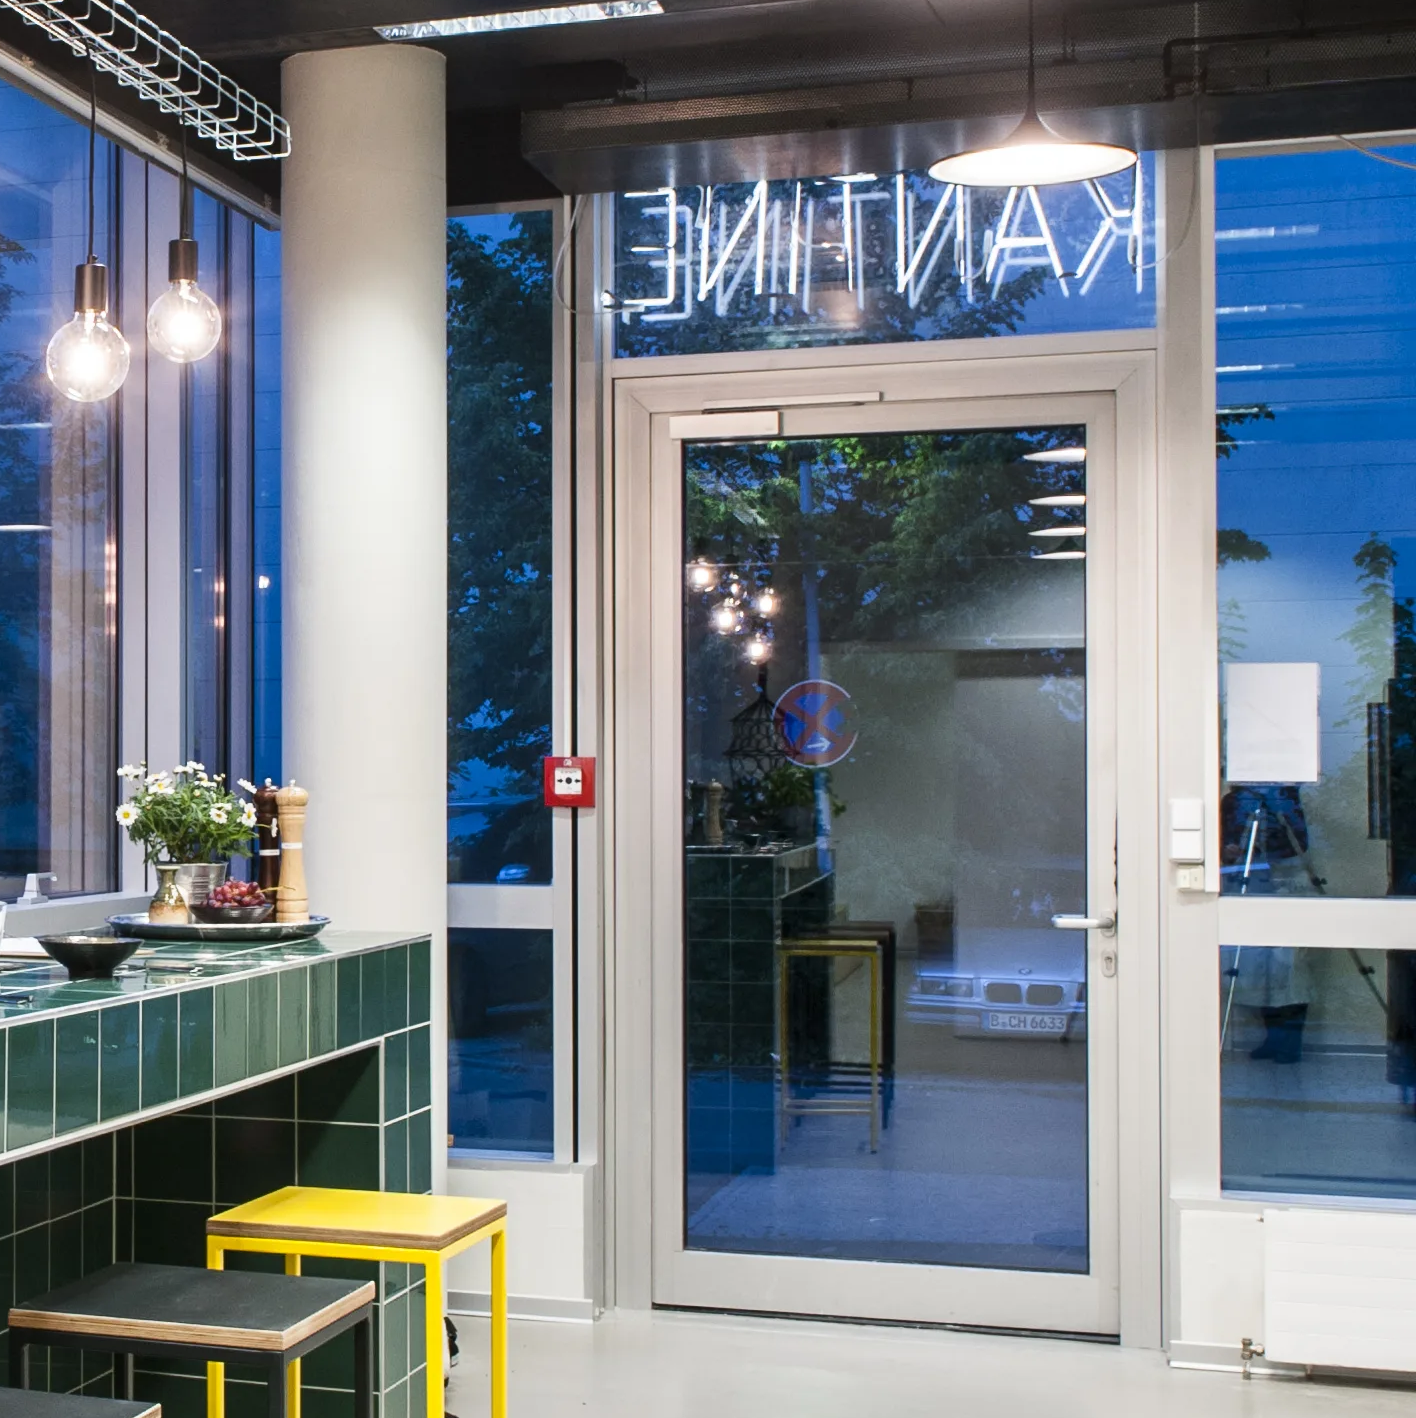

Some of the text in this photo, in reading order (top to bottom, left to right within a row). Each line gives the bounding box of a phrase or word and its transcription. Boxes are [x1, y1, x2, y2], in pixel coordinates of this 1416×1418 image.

[990, 1014, 1064, 1030] B CH 6633
